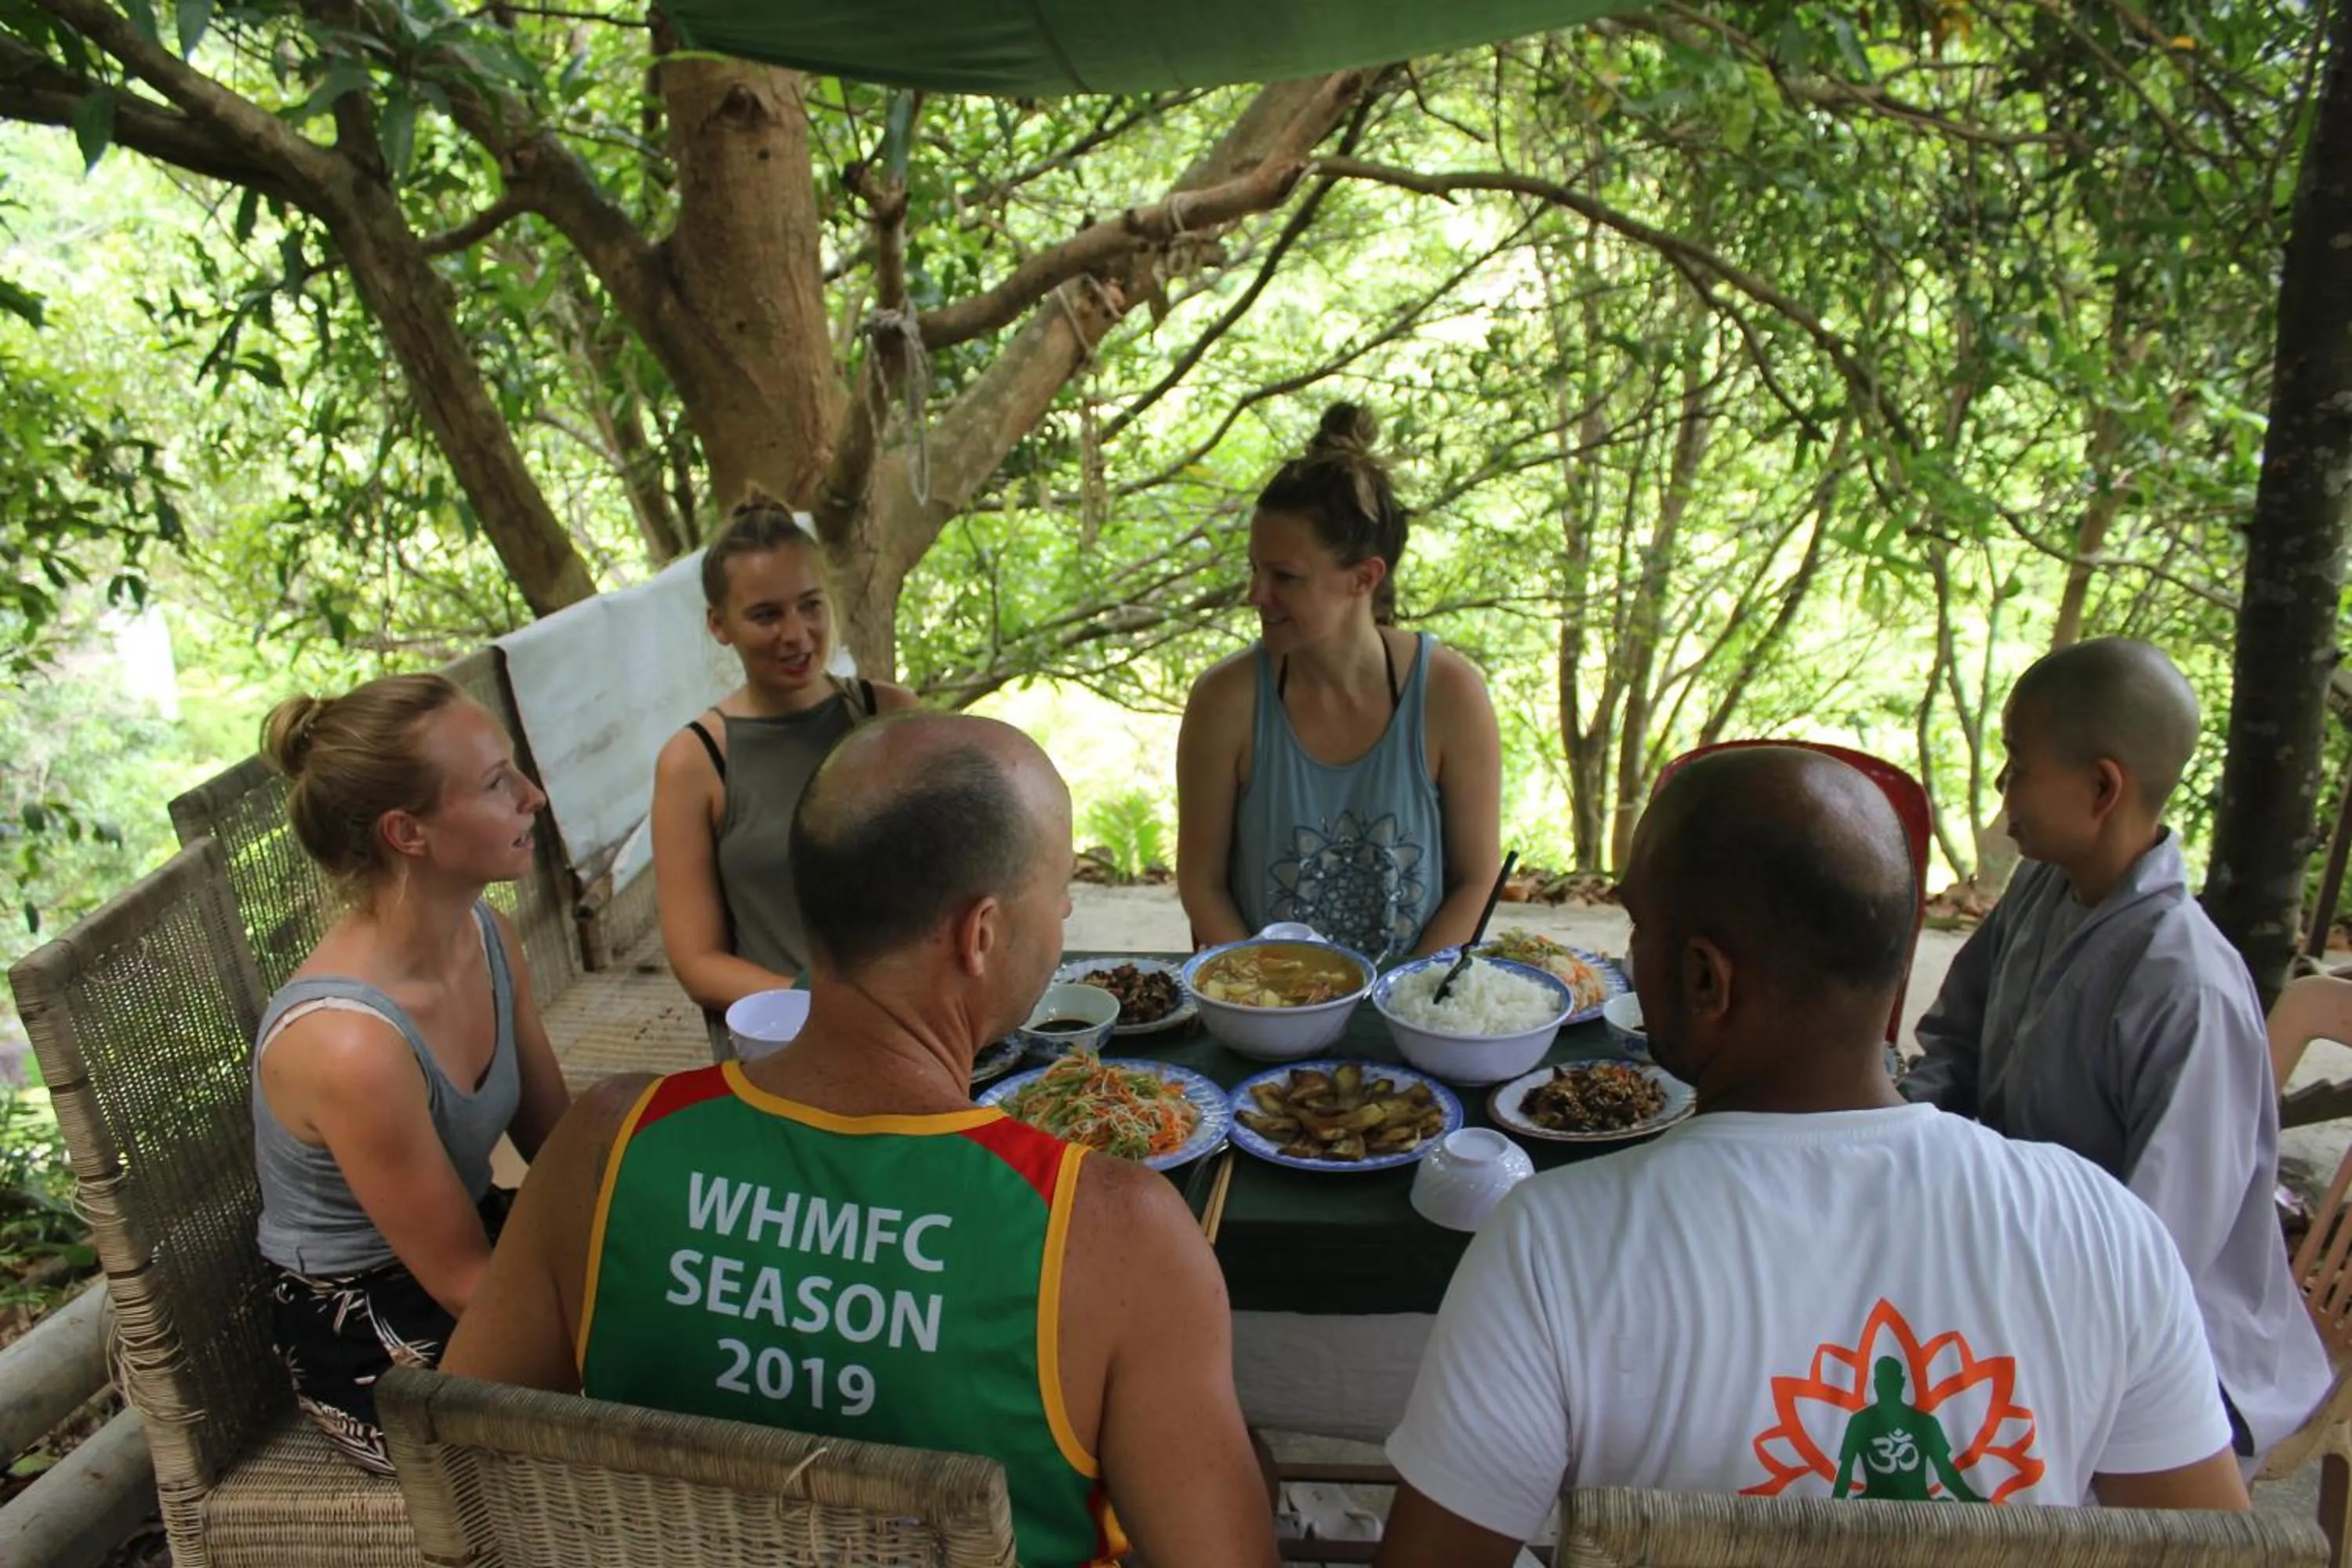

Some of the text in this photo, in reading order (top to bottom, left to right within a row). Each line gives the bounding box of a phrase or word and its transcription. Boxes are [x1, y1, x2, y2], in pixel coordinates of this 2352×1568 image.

[688, 1171, 953, 1272] WHMFC
[666, 1249, 944, 1353] SEASON
[714, 1338, 877, 1417] 2019
